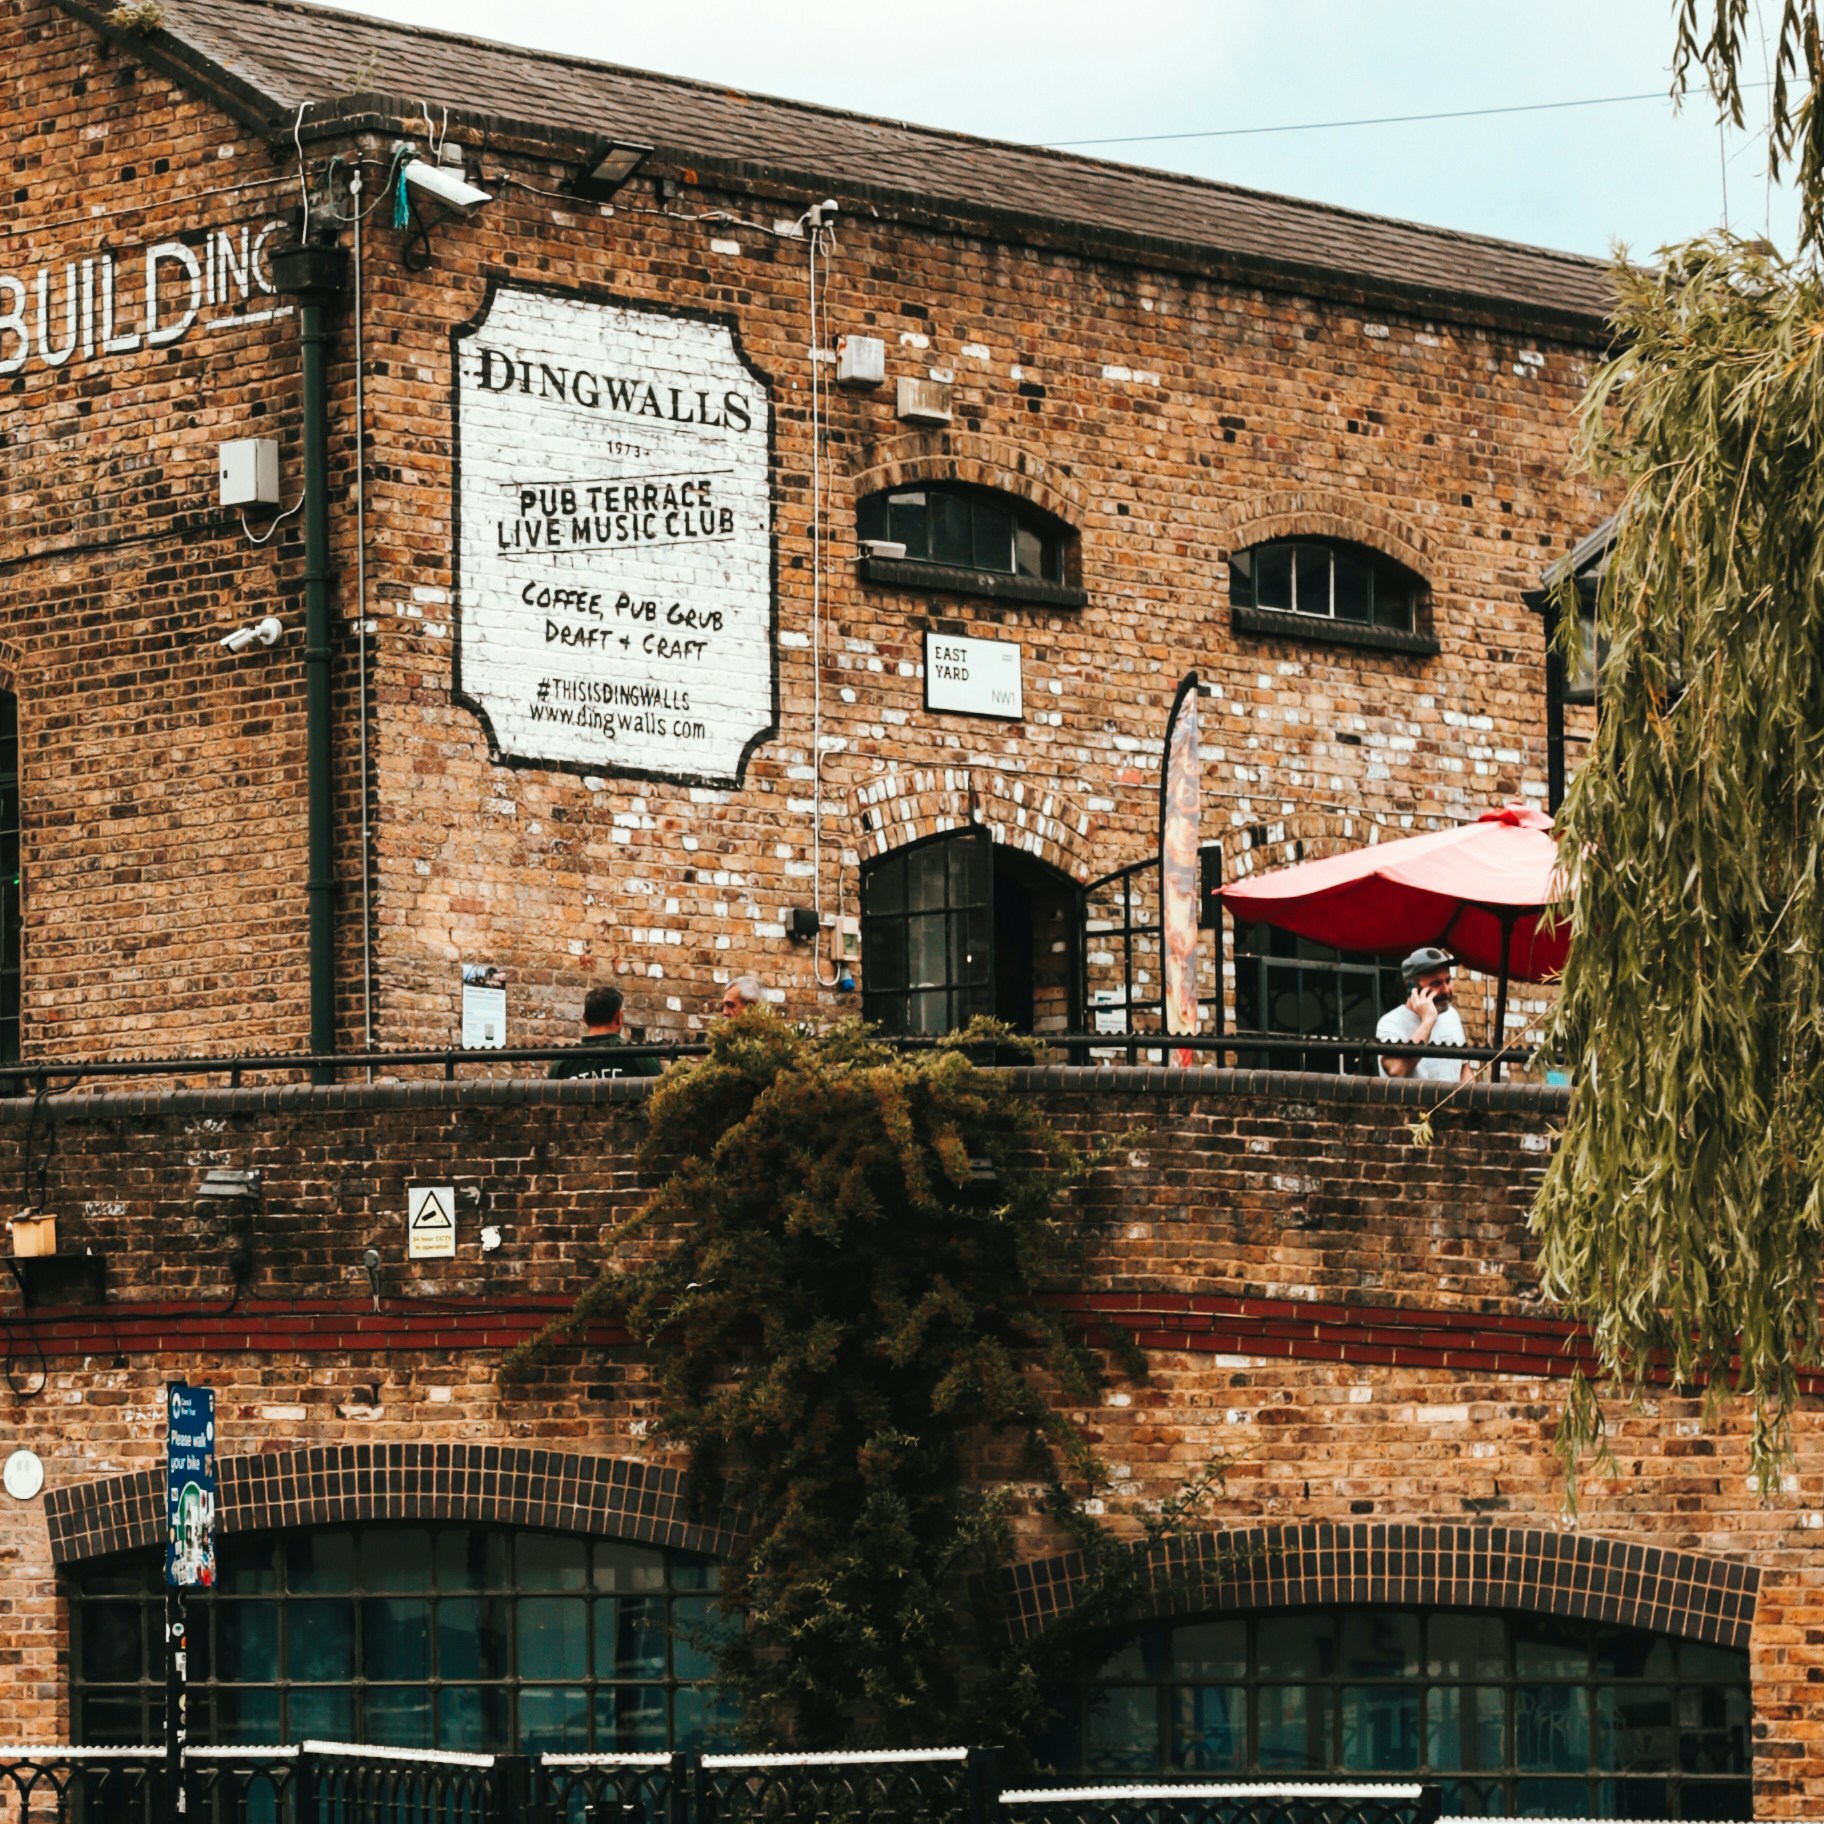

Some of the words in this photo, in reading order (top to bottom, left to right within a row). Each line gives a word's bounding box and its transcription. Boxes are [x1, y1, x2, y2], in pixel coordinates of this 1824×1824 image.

[477, 347, 752, 433] DINGWALLS
[520, 488, 576, 517] PUB
[587, 480, 712, 513] TERRACE
[497, 518, 561, 548] LIVE
[572, 513, 656, 544] MUSIC
[665, 507, 734, 537] CLUB
[522, 581, 603, 621] COFFEE,
[615, 591, 657, 622] PUB
[666, 603, 724, 632] GRUB
[545, 618, 614, 650] DRAFT
[643, 633, 708, 661] CRAFT
[935, 646, 968, 663] EAST
[935, 664, 970, 681] YARD
[537, 678, 690, 711] #THISISDINGWALLS
[991, 689, 1015, 705] NW1
[171, 1429, 192, 1447] Please
[193, 1432, 206, 1448] walk
[170, 1457, 186, 1474] your
[186, 1454, 201, 1470] bike
